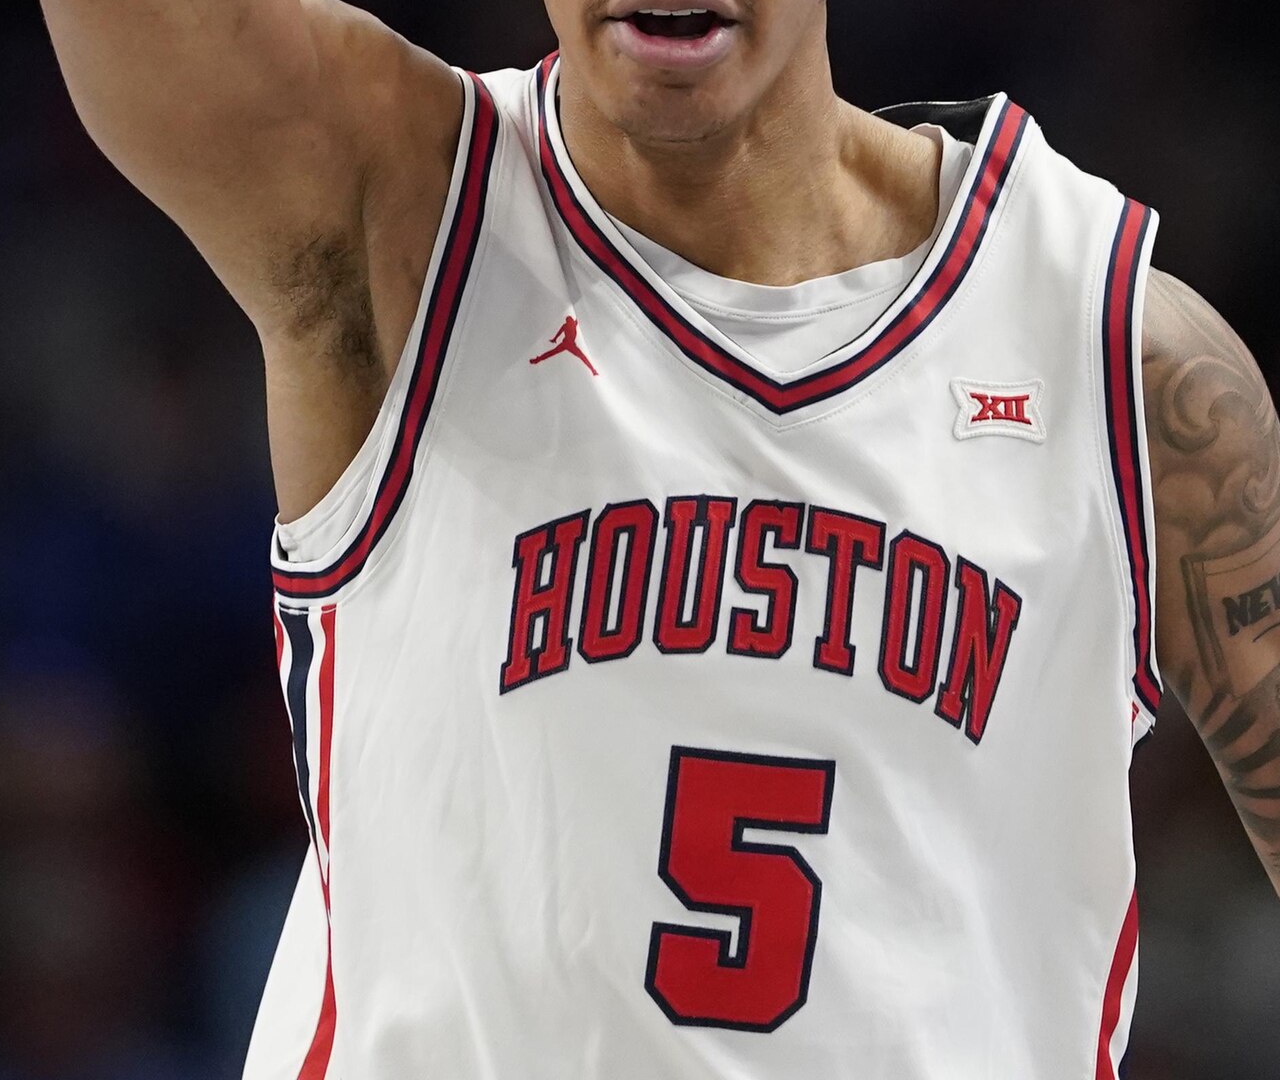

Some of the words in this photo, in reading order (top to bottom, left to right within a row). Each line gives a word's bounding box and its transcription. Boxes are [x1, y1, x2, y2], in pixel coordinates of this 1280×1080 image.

[969, 392, 1032, 425] XII
[500, 494, 1022, 745] HOUSTON
[644, 745, 836, 1033] 5
